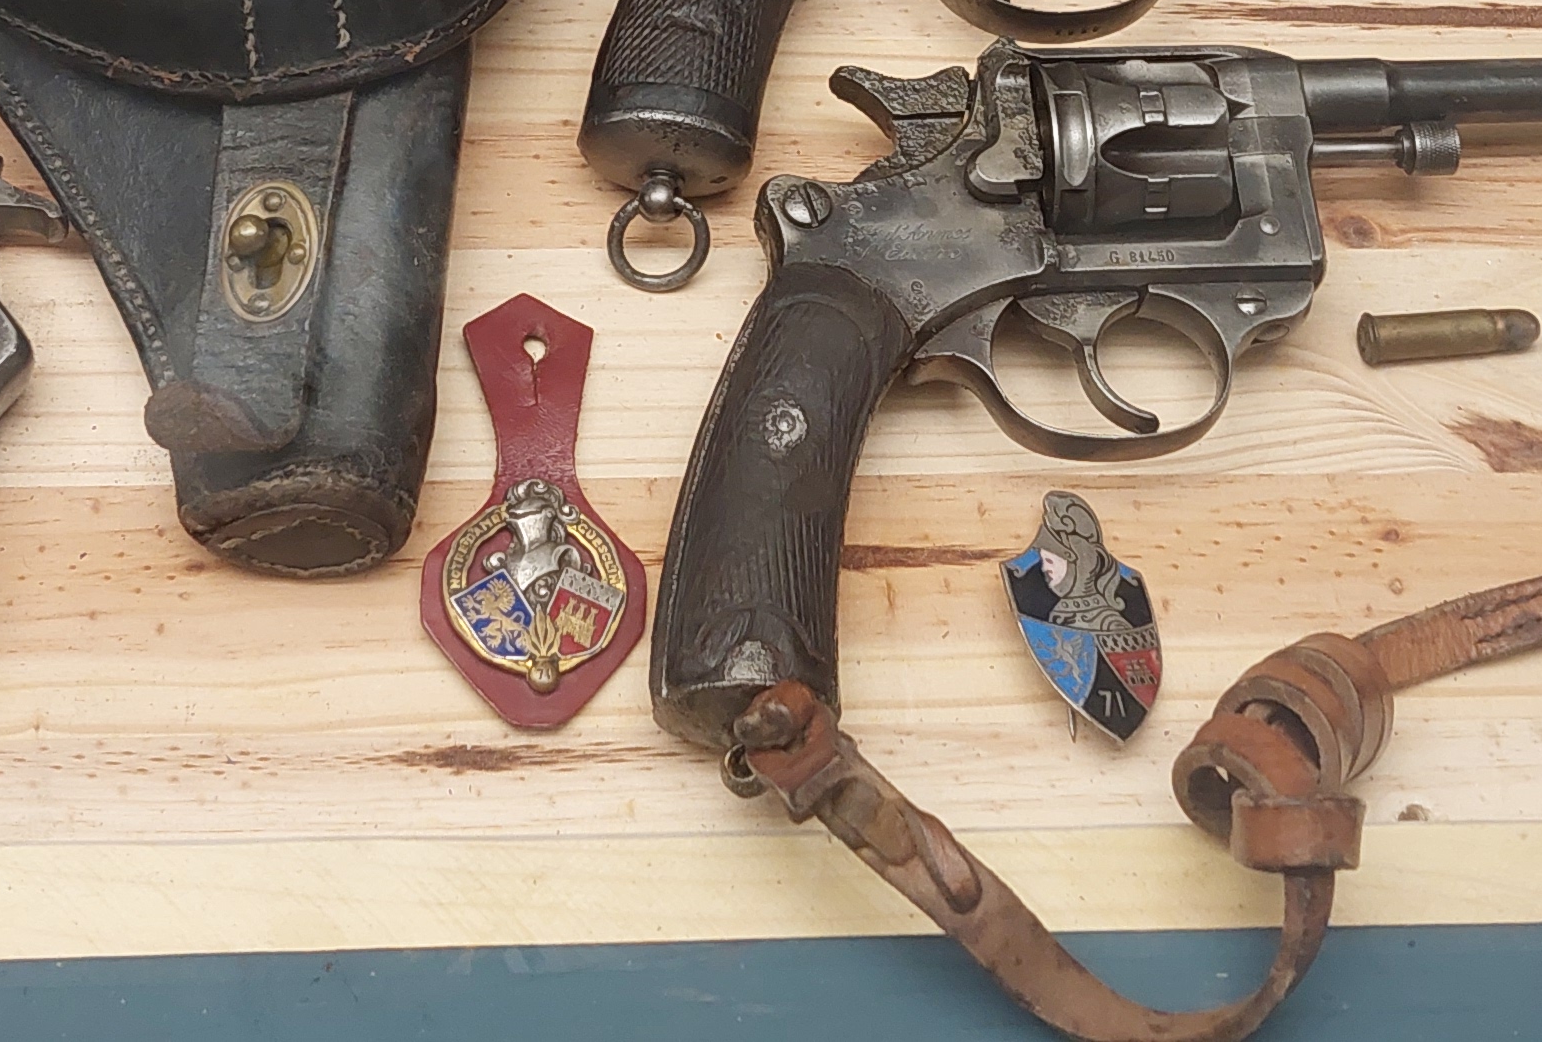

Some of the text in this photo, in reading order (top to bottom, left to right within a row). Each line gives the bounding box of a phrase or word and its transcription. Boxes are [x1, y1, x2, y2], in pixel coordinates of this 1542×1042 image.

[1109, 249, 1122, 265] G
[577, 521, 623, 589] GUESCLIN
[1098, 689, 1126, 718] 71
